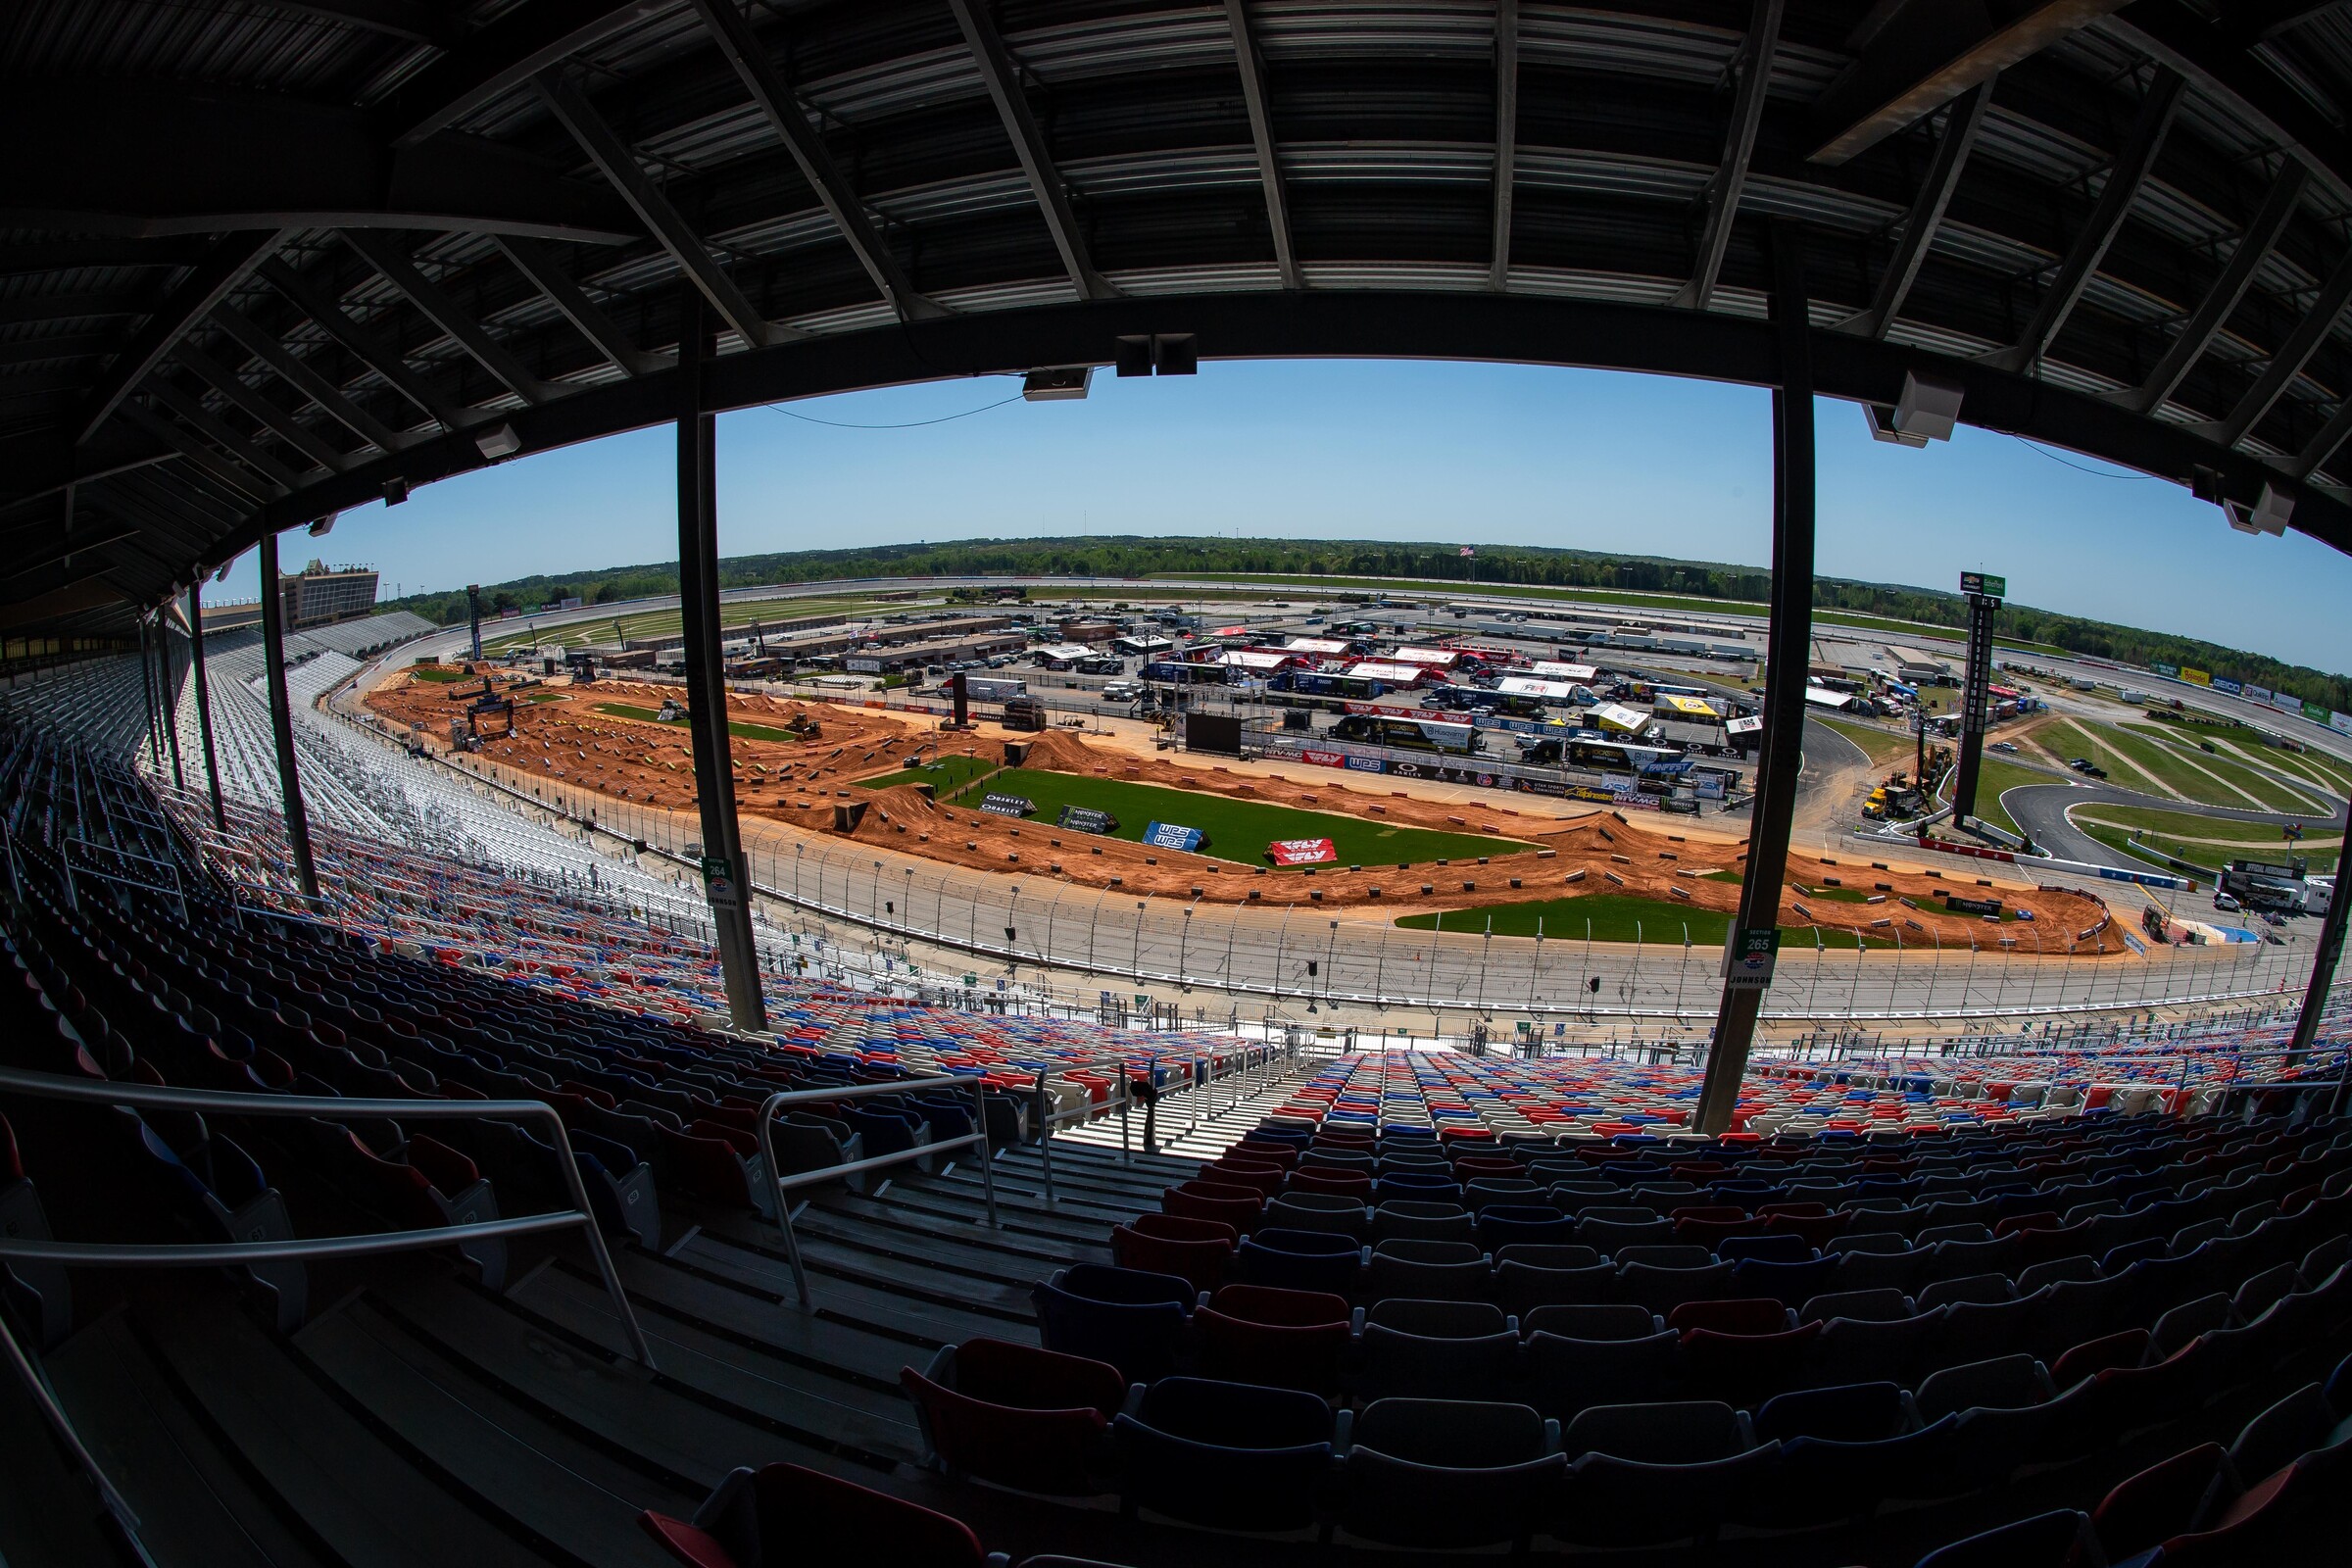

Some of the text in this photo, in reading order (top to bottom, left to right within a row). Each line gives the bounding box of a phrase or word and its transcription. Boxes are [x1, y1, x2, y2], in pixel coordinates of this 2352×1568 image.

[2215, 678, 2240, 693] GEICO
[1475, 716, 1501, 728] WPS
[1509, 720, 1535, 732] WPS
[1543, 725, 1568, 736] WPS
[1435, 728, 1465, 739] Husqvarna
[1349, 758, 1381, 772] WPS
[1648, 762, 1688, 772] FANFEST
[996, 797, 1025, 806] OAKLEY
[1670, 800, 1694, 808] MONSTER
[992, 806, 1020, 815] OAKLEY
[1074, 808, 1102, 820] MONSTER
[1070, 819, 1098, 829] MONSTER
[1157, 823, 1191, 837] WPS
[1152, 835, 1186, 849] WPS
[1286, 839, 1323, 850] FLY
[1288, 851, 1326, 860] FLY
[710, 865, 726, 877] 264
[2245, 863, 2293, 878] OFFICIAL MERCHANDISE
[708, 897, 737, 906] JOHNSON
[1962, 901, 1992, 911] MONSTER
[1746, 939, 1770, 951] 265
[466, 1214, 474, 1224] 60
[252, 1228, 264, 1242] 61
